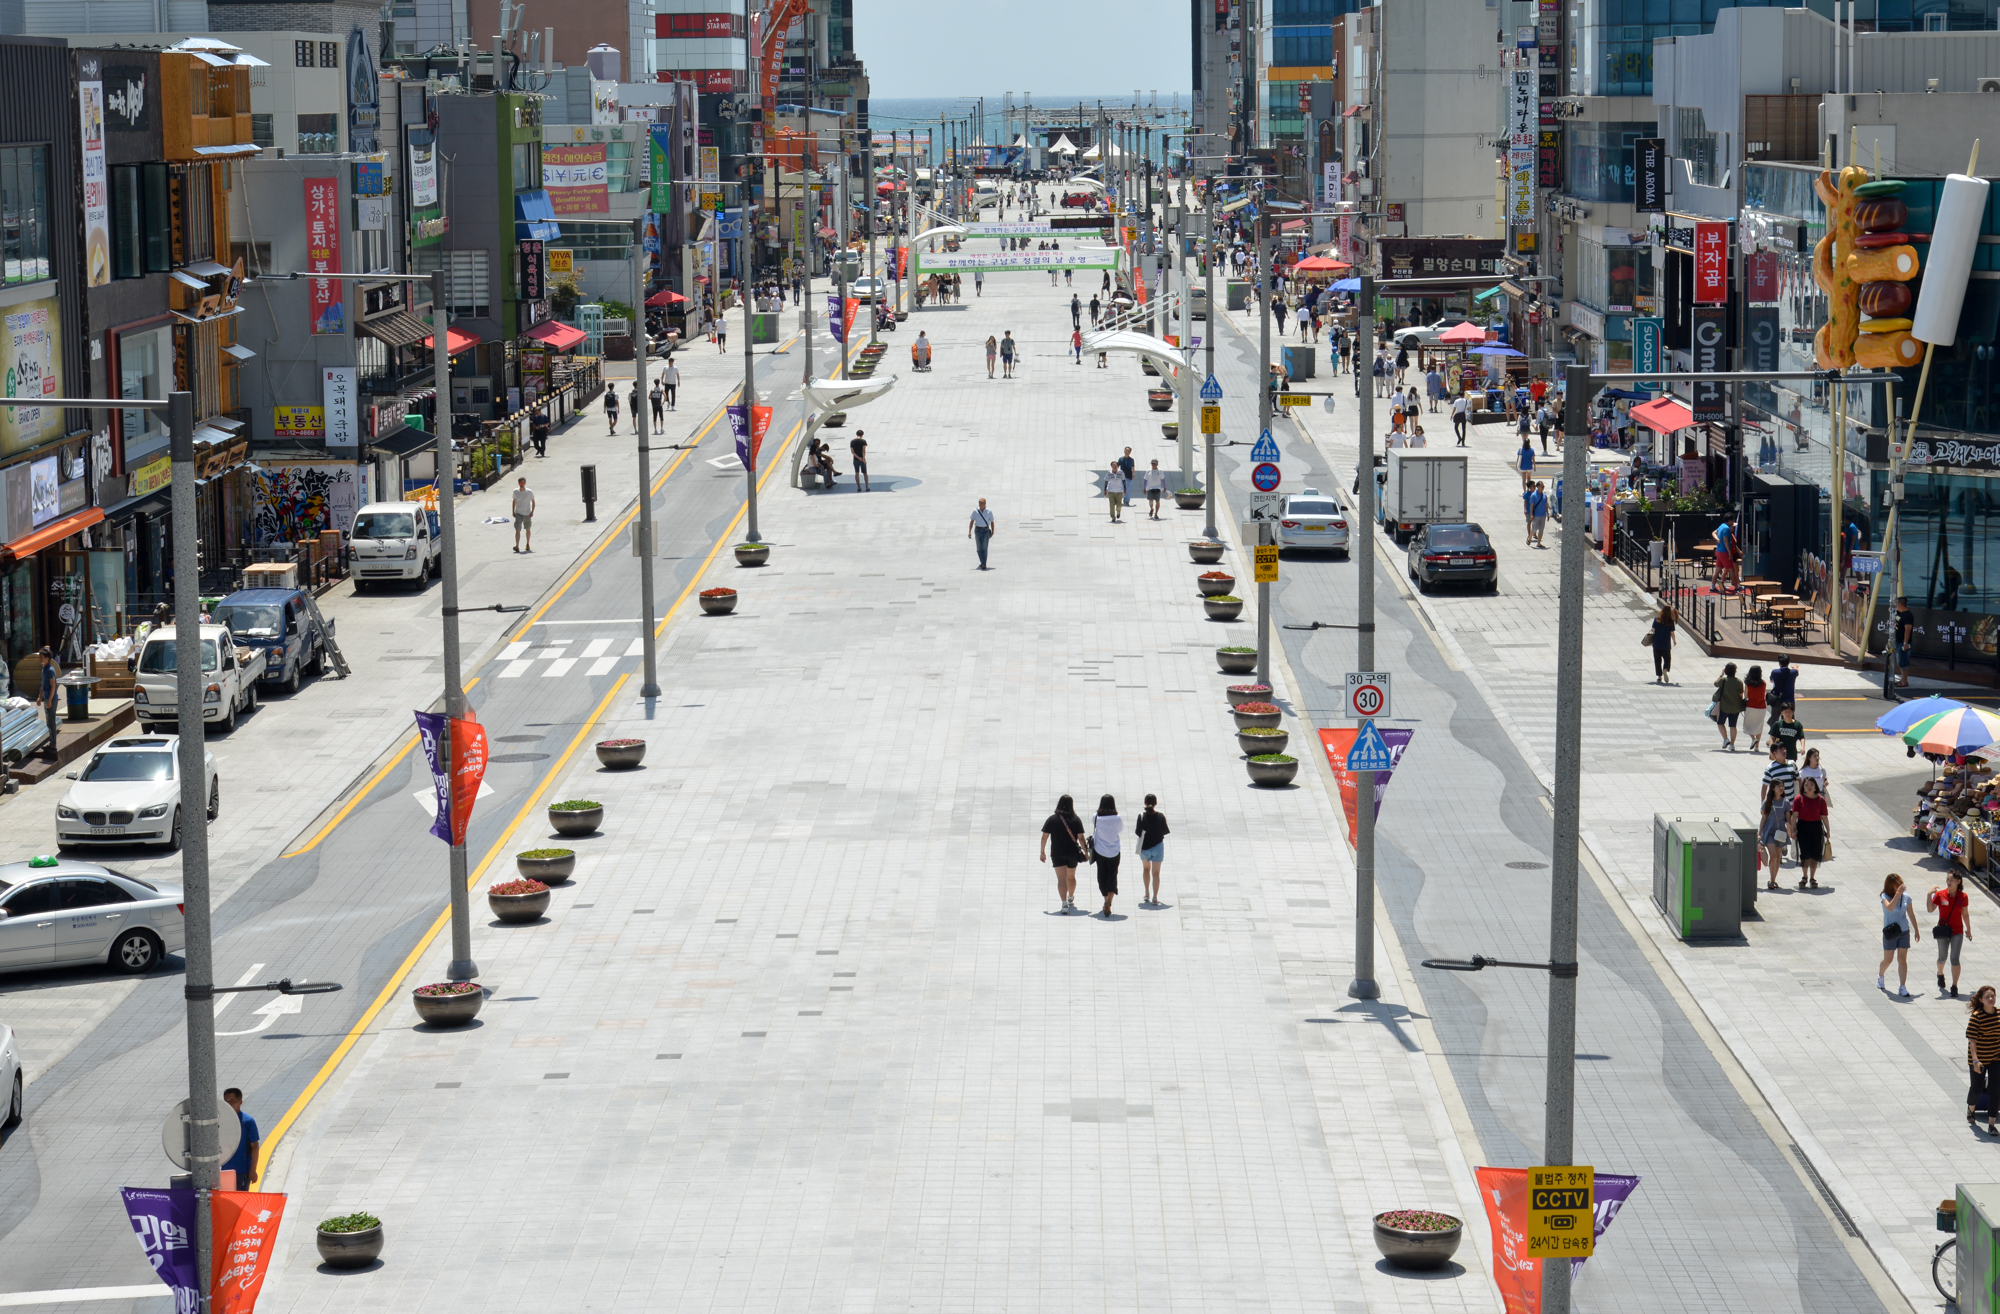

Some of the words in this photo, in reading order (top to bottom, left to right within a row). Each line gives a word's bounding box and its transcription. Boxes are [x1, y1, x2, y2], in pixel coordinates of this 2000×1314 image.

[1517, 73, 1528, 83] 10
[1516, 86, 1529, 133] 노래타운
[591, 128, 623, 141] 농협
[1645, 148, 1655, 168] THE
[592, 167, 604, 180] €
[1540, 149, 1555, 186] 마사지
[358, 175, 382, 192] 부동산
[1645, 170, 1656, 204] AROMA
[1516, 171, 1530, 214] 야구존
[311, 248, 330, 259] 전문
[522, 242, 542, 254] 청춘
[550, 252, 571, 260] VIVA
[948, 259, 986, 267] 함께하는
[1023, 256, 1050, 264] 청결의
[1704, 232, 1722, 288] 부자곱
[554, 260, 568, 268] 청춘
[1423, 258, 1477, 272] 밀양순대
[1642, 325, 1653, 385] atsons
[333, 374, 350, 443] 오복돼지국밥
[277, 414, 323, 429] 부동산
[1256, 555, 1276, 563] CCTV
[1852, 562, 1872, 572] 주차장
[1872, 562, 1878, 570] P
[1350, 674, 1363, 685] 30
[1365, 674, 1387, 684] 구역
[1360, 692, 1378, 708] 30
[1352, 761, 1388, 770] 횡단보도
[1534, 1172, 1588, 1186] 불법주·정차
[1536, 1192, 1584, 1208] CCTV
[132, 1214, 189, 1251] 리얼
[1530, 1236, 1560, 1250] 24시간
[1562, 1238, 1590, 1250] 단속중
[234, 1251, 259, 1264] 매직
